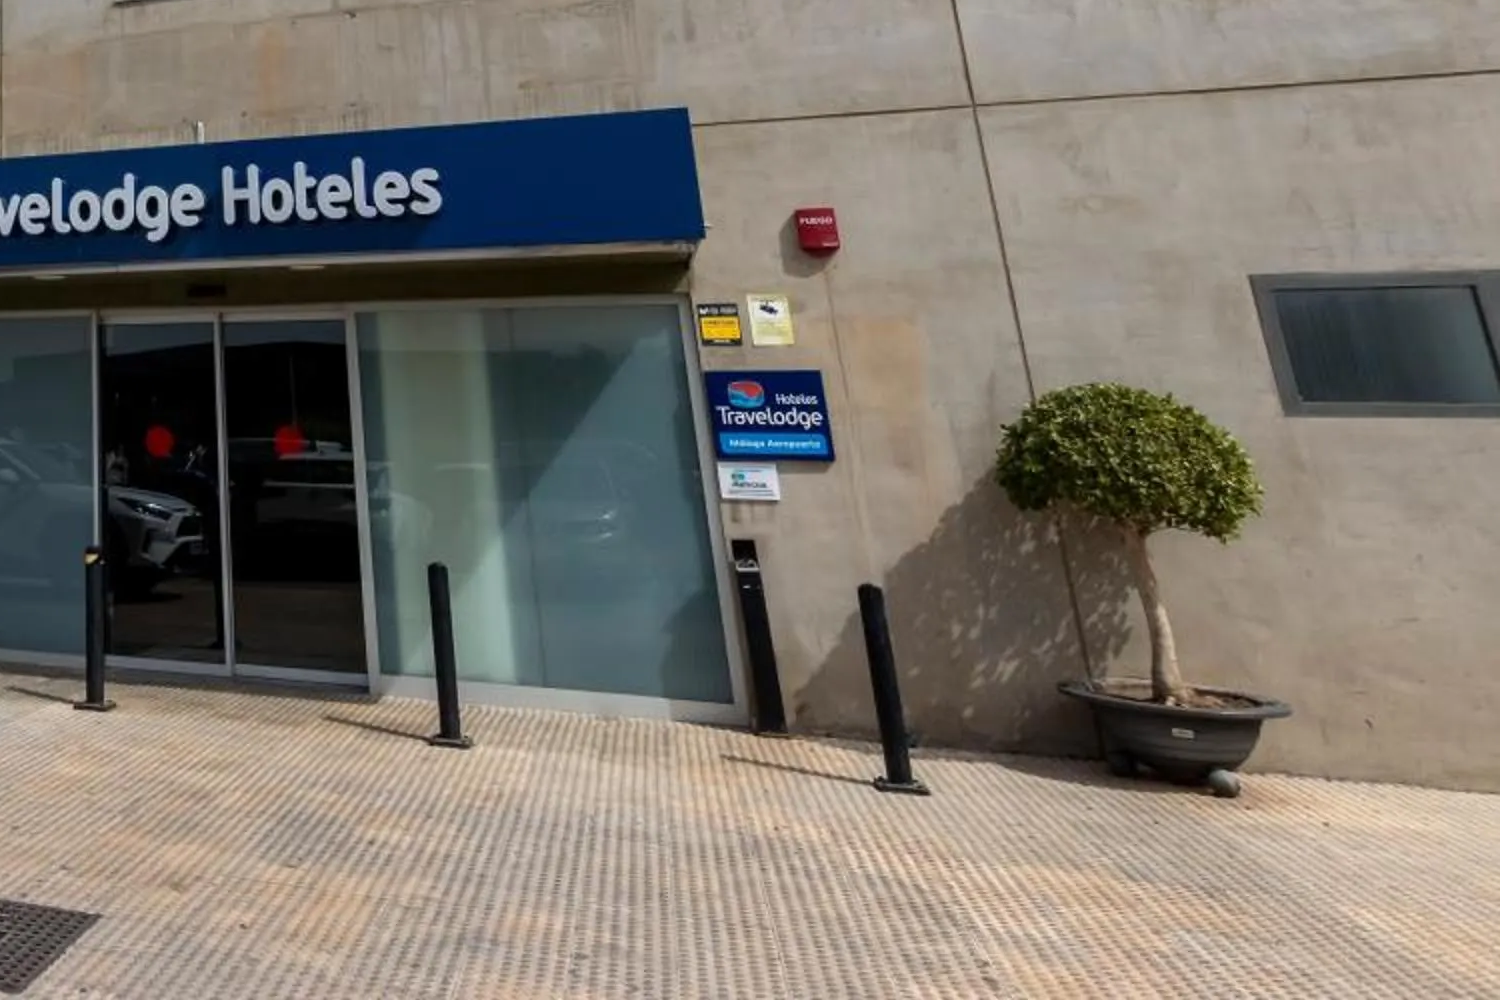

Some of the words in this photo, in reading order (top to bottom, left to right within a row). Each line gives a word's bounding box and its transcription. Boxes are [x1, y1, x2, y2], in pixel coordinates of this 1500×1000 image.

[221, 156, 443, 226] Hoteles
[775, 393, 819, 405] Hoteles
[715, 405, 824, 431] Travelodge
